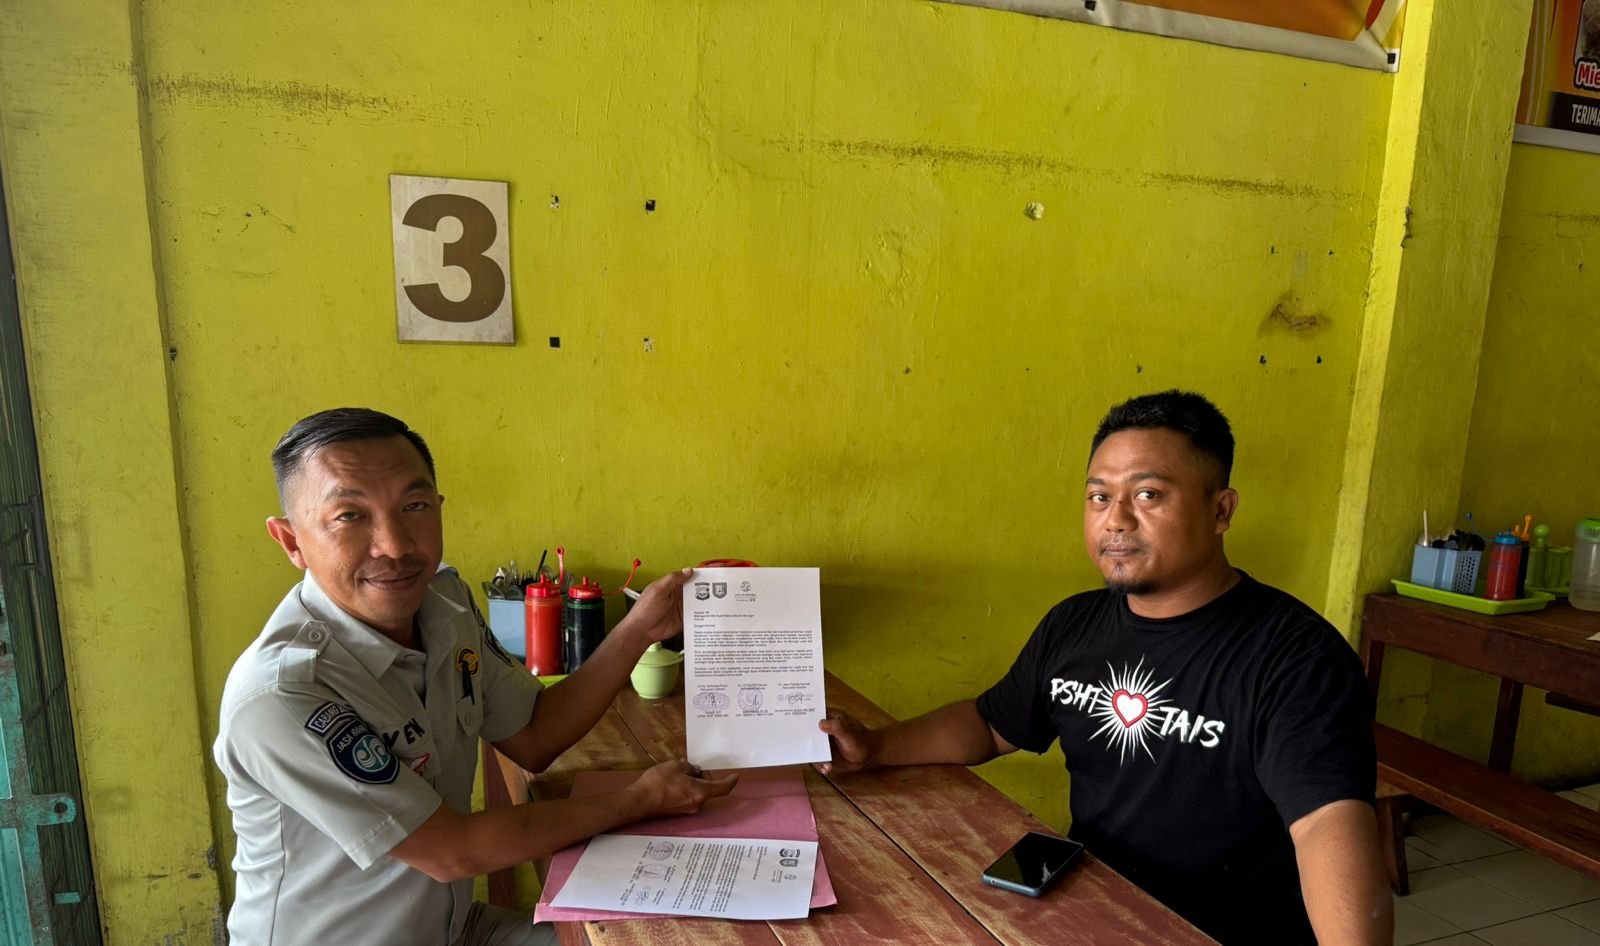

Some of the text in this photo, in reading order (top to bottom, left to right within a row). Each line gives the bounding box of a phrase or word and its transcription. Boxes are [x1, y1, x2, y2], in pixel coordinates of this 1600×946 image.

[402, 194, 506, 322] 3
[314, 705, 340, 728] CABANG
[1050, 678, 1225, 747] PSHT TAIS
[336, 733, 354, 753] JASA
